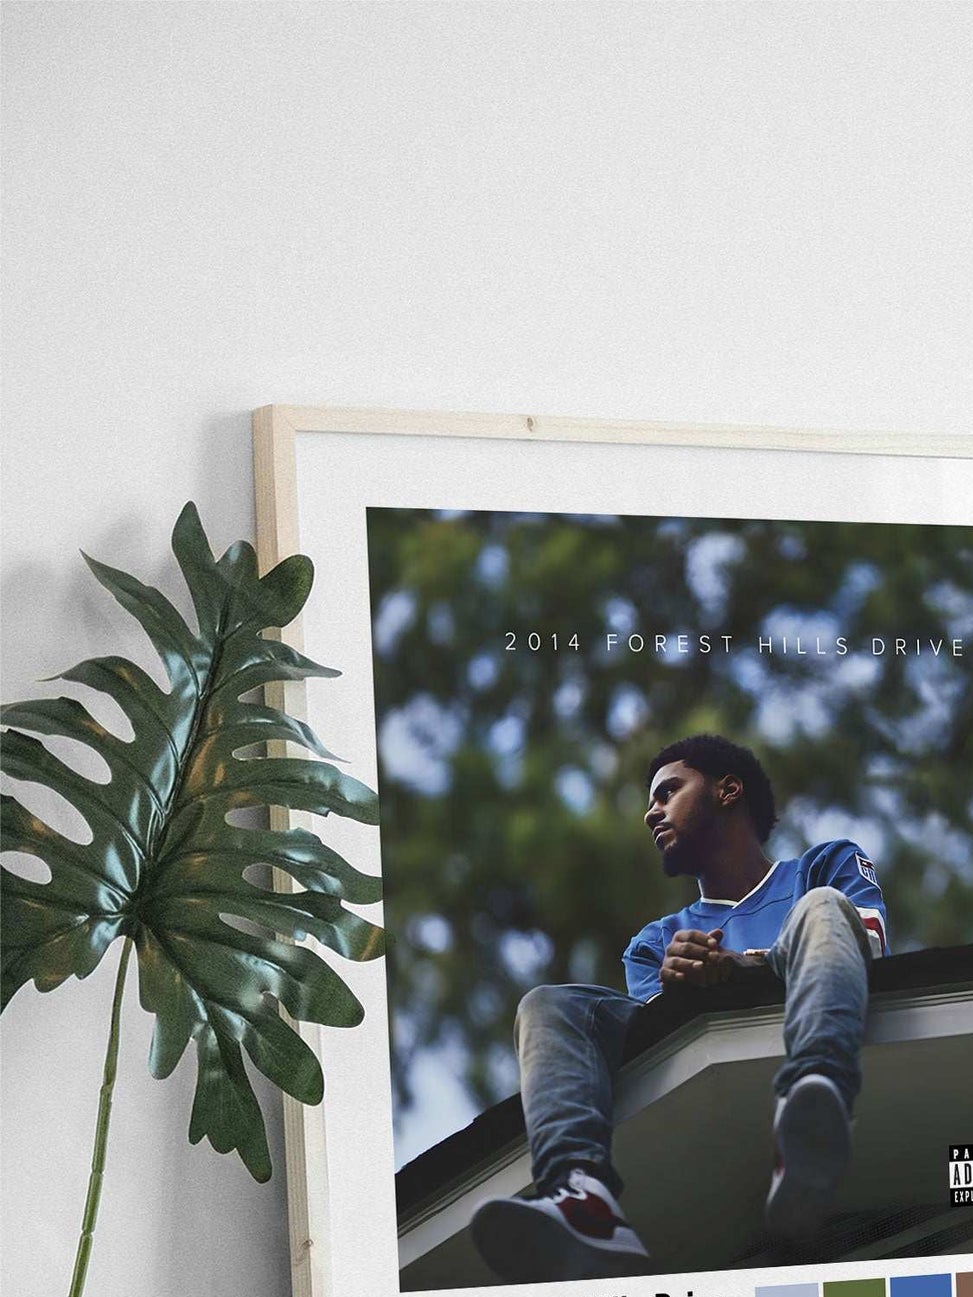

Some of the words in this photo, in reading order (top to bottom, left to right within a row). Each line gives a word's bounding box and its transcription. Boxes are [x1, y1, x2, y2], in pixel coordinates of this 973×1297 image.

[505, 632, 580, 651] 2014
[607, 633, 733, 654] FOREST
[758, 636, 849, 655] HILLS
[872, 638, 964, 657] DRIVE
